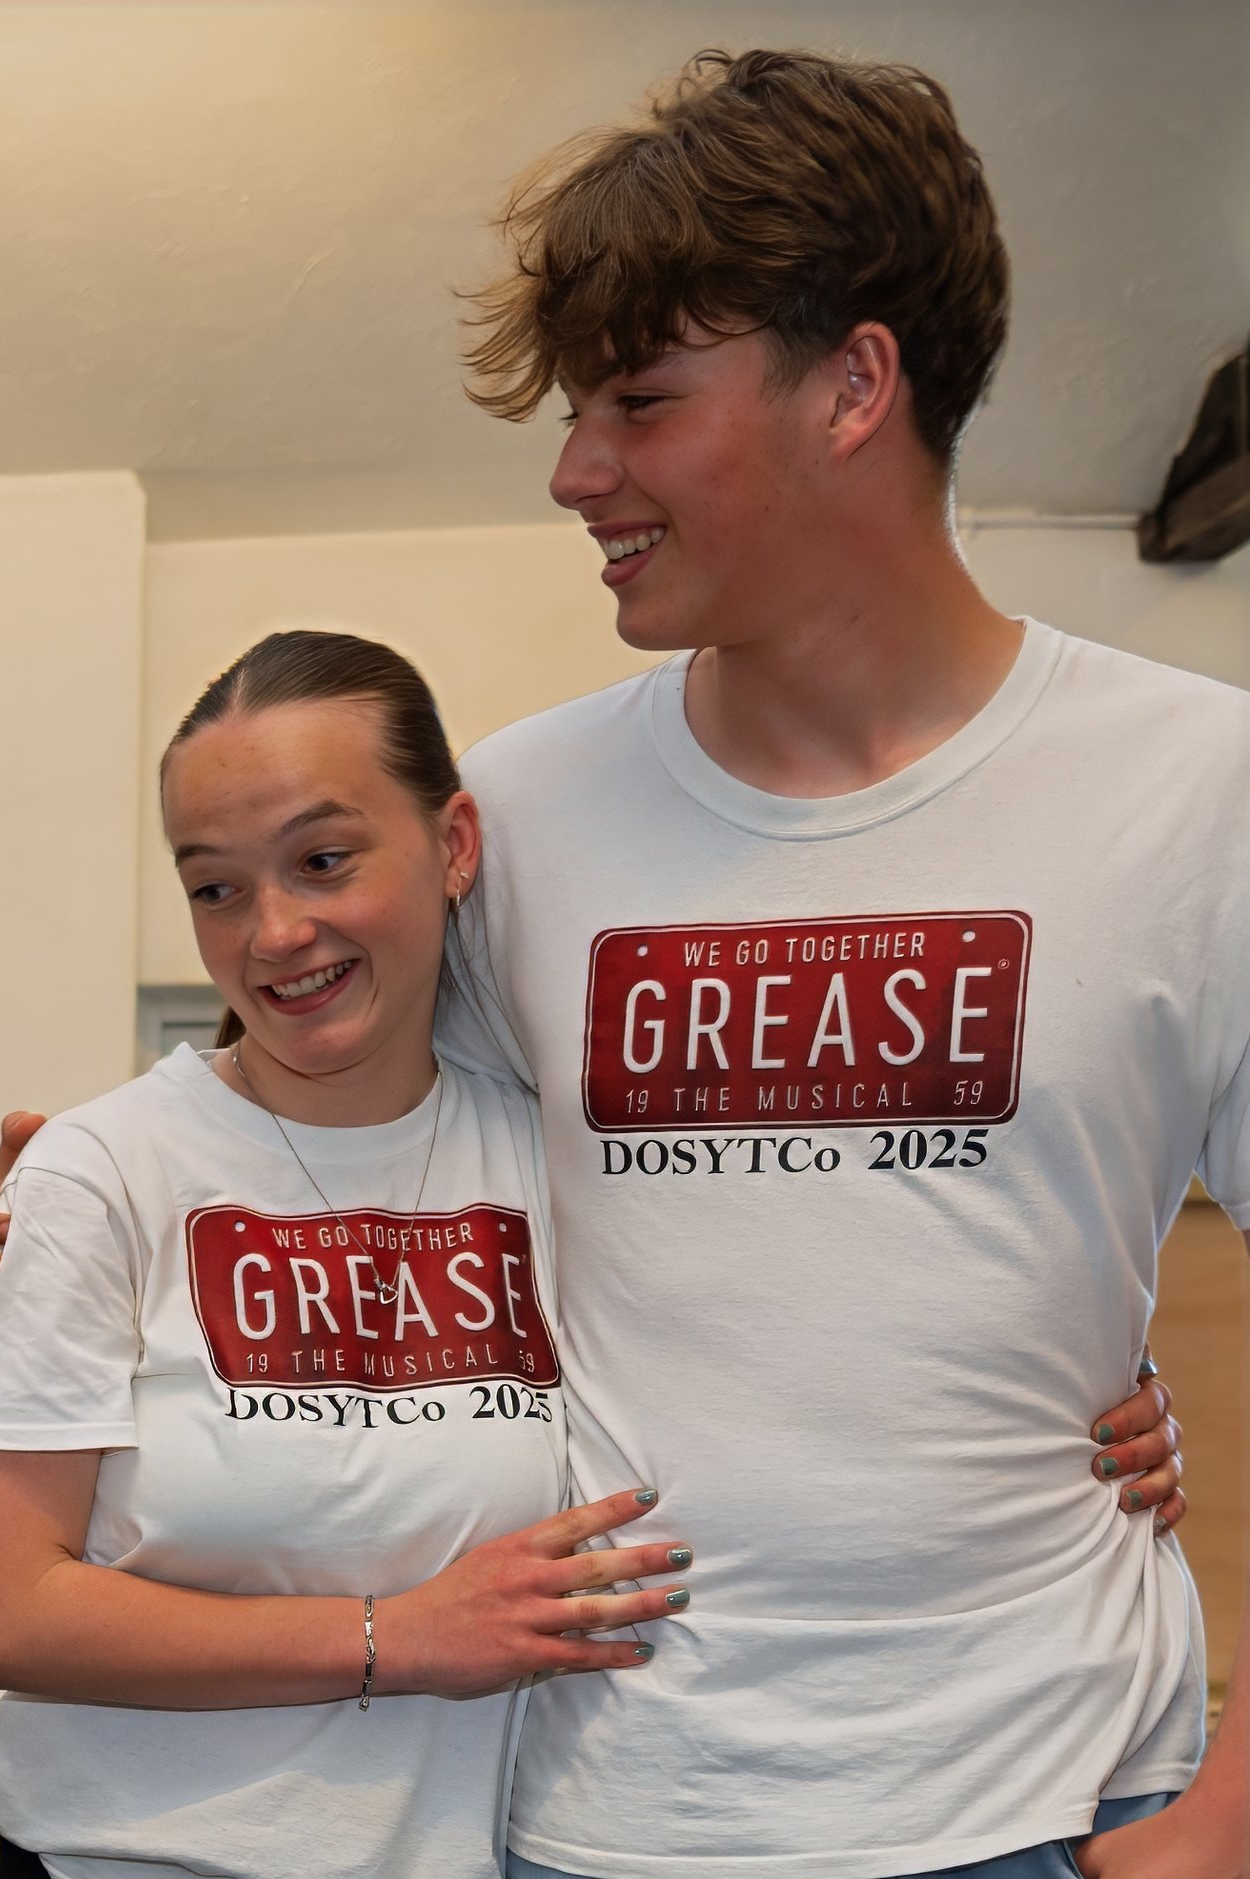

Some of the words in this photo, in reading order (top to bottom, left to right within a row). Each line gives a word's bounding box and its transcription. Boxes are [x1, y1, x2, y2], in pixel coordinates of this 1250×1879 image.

[684, 940, 721, 967] WE
[735, 939, 769, 966] GO
[785, 931, 925, 963] TOGETHER
[622, 966, 993, 1074] GREASE
[626, 1088, 649, 1114] 19
[674, 1086, 731, 1112] THE
[758, 1081, 912, 1111] MUSICAL
[953, 1080, 984, 1106] 59
[600, 1136, 841, 1176] DOSYTCo
[867, 1128, 990, 1171] 2025
[272, 1227, 307, 1250] WE
[319, 1226, 349, 1248] GO
[361, 1222, 474, 1251] TOGETHER
[232, 1251, 527, 1341] GREASE
[246, 1353, 268, 1373] 19
[291, 1349, 346, 1374] THE
[363, 1344, 499, 1377] MUSICAL
[224, 1386, 446, 1429] DOSYTCo
